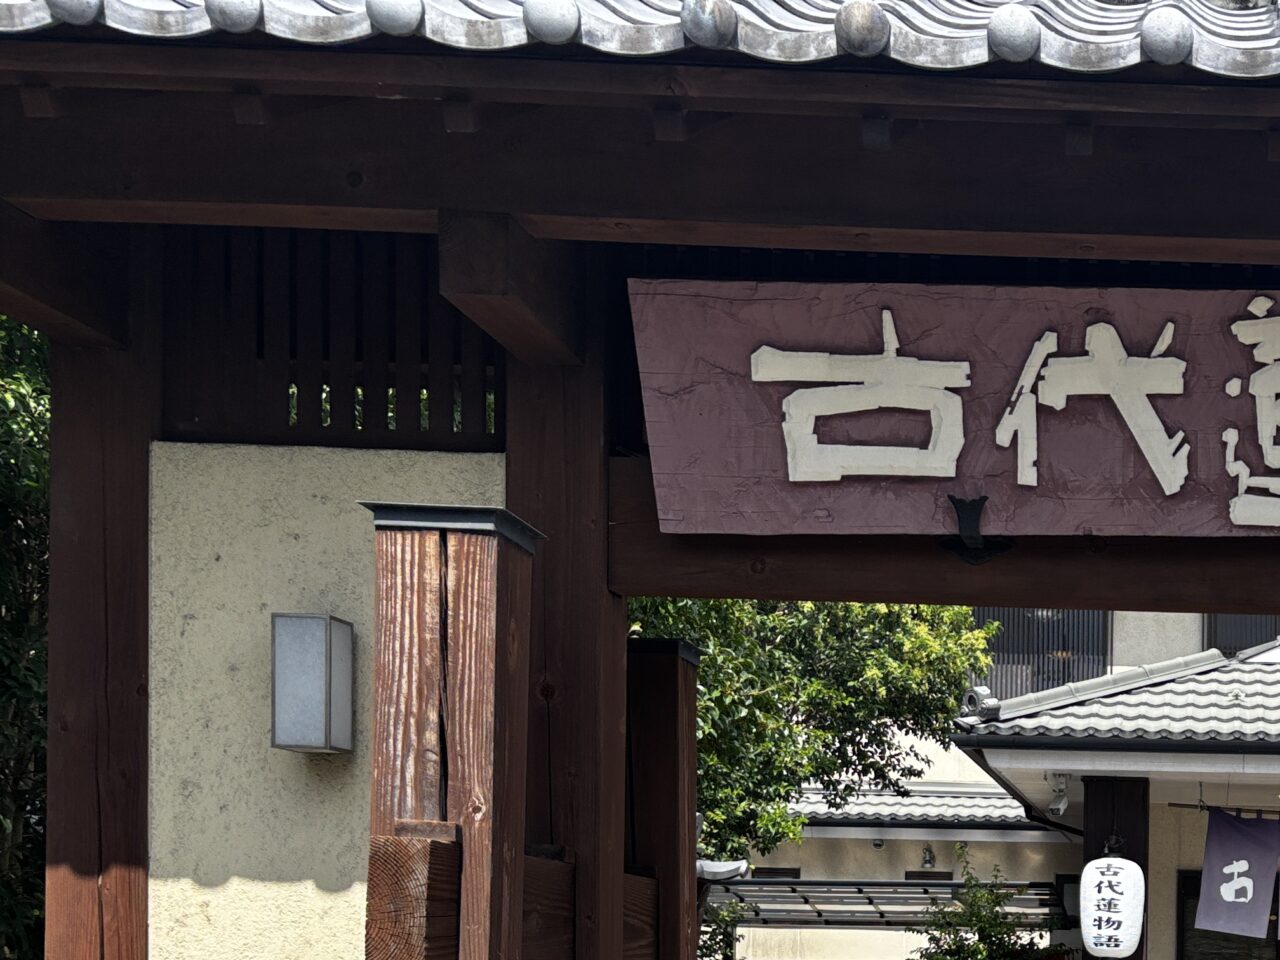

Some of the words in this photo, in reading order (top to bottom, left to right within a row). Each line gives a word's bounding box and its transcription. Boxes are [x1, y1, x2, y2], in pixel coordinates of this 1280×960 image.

[1093, 863, 1125, 948] 古代蓮物語
